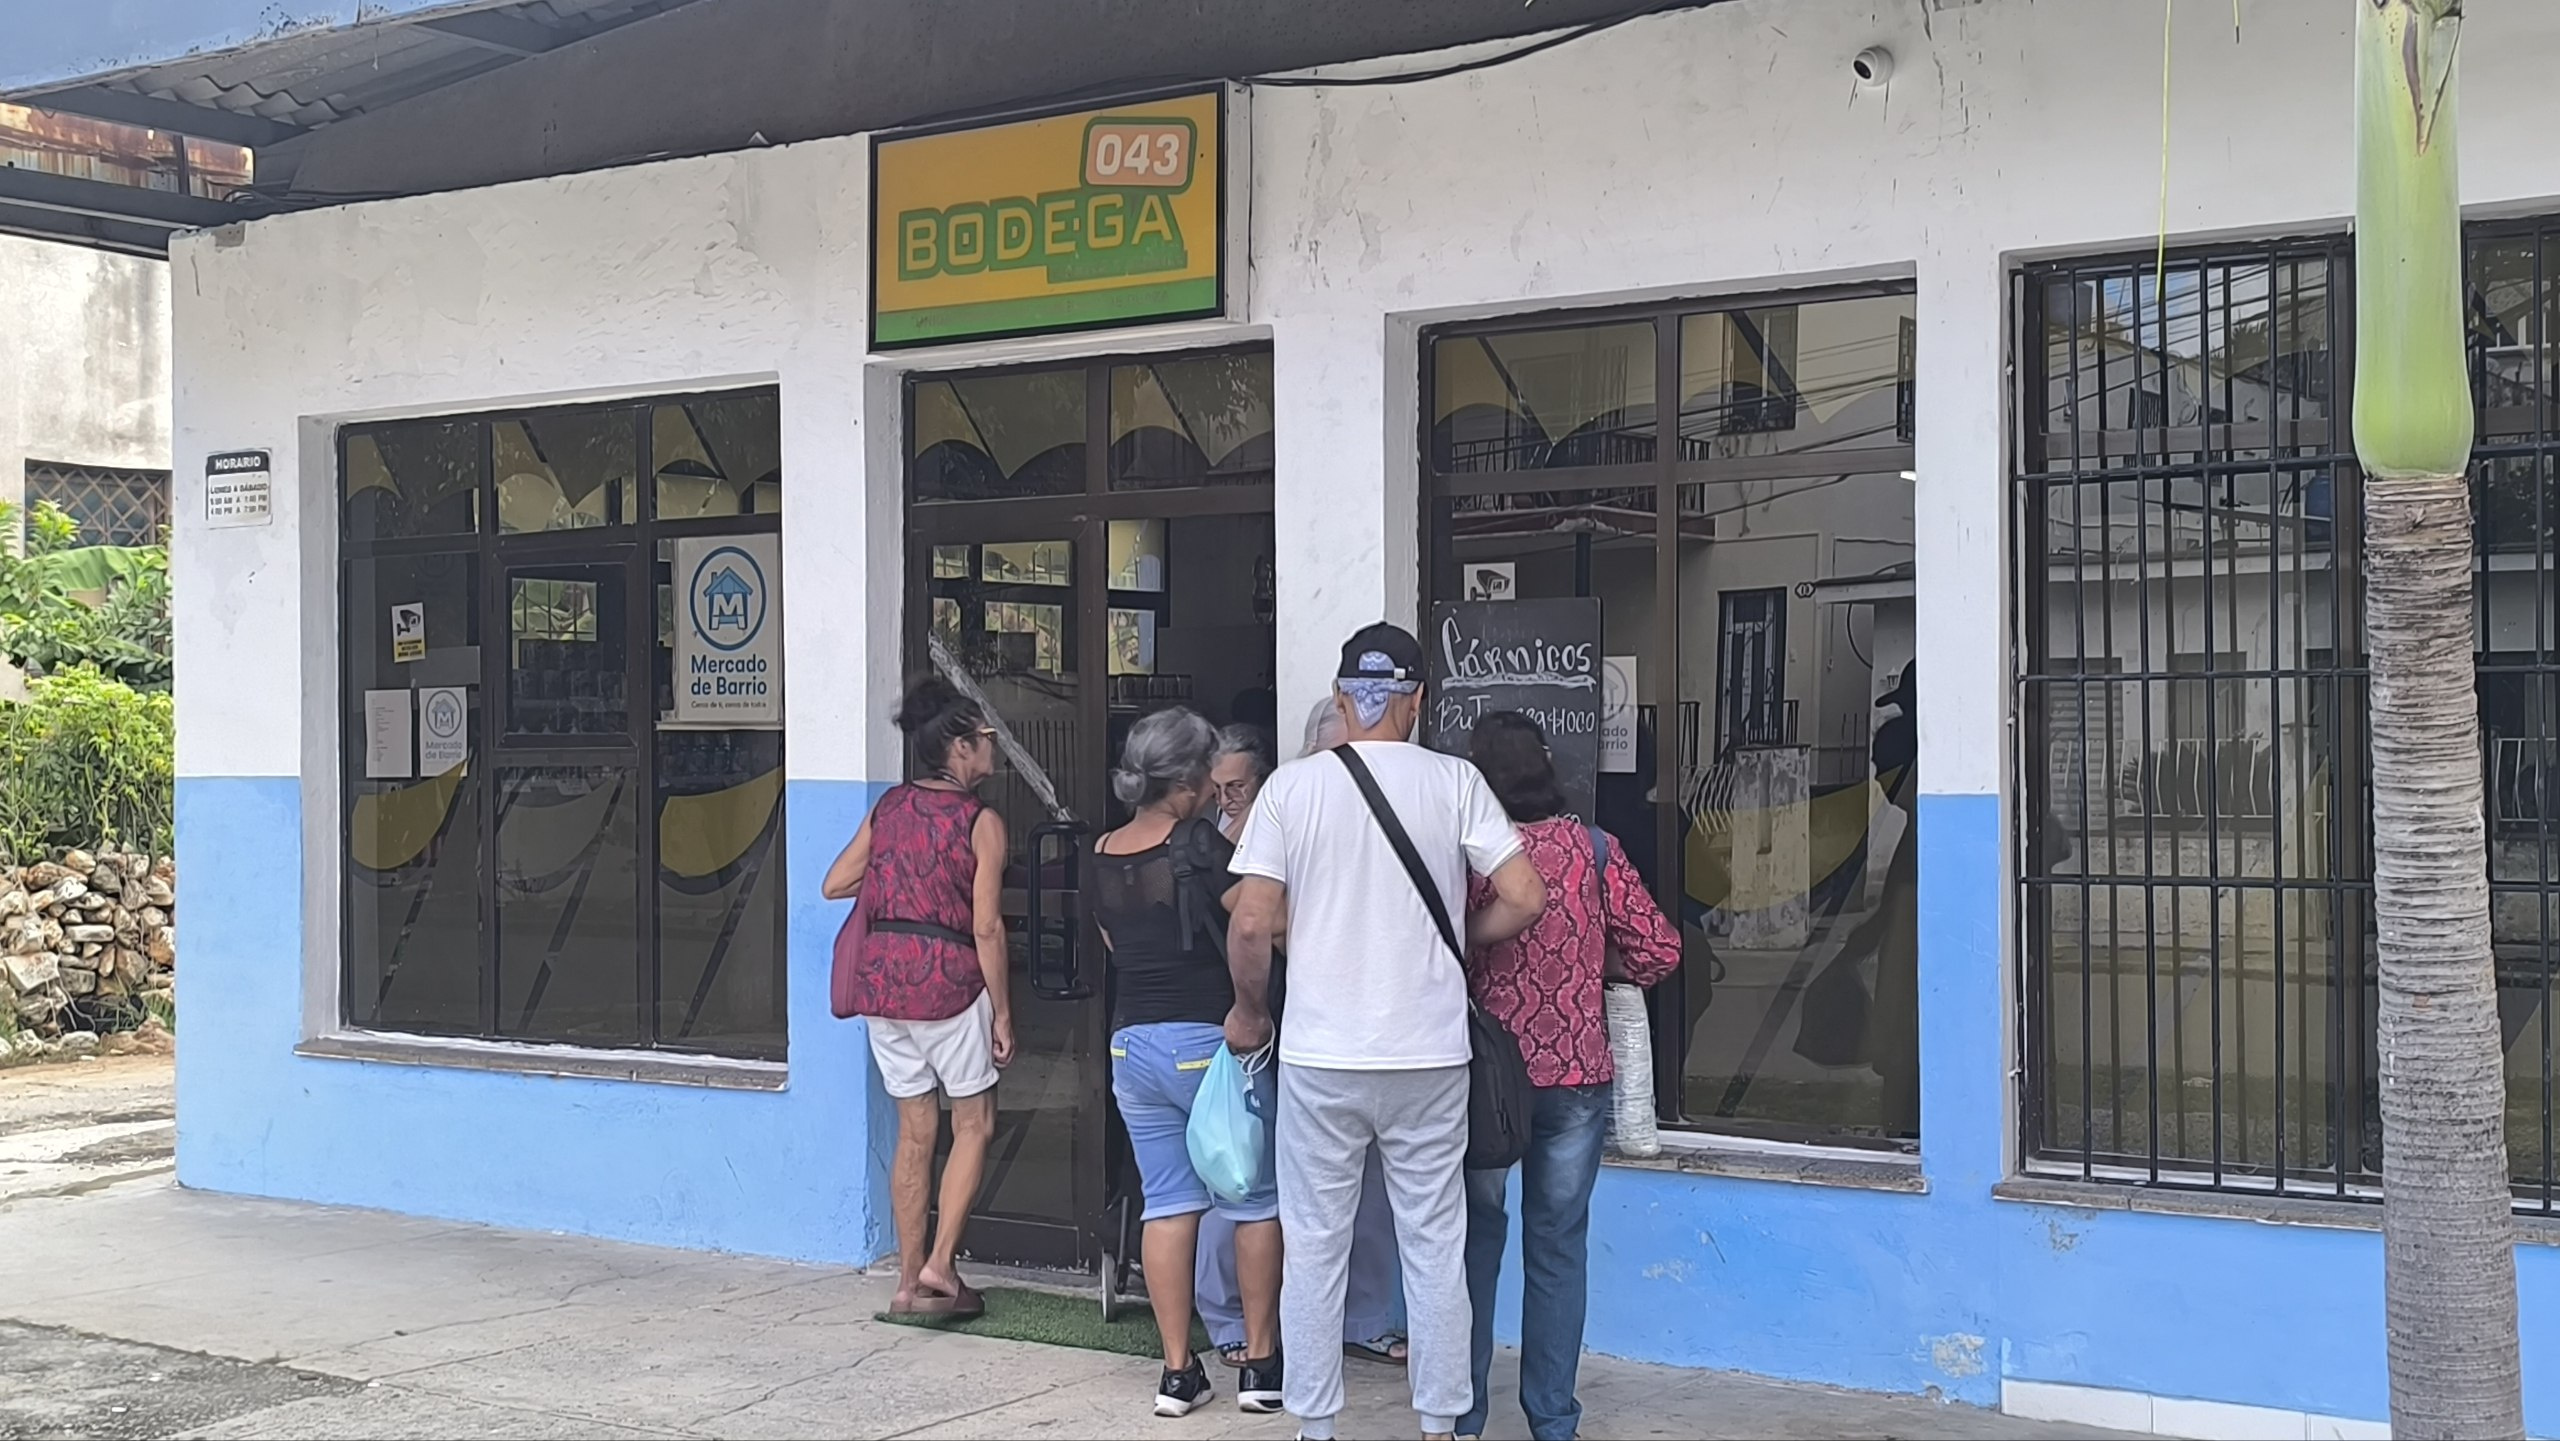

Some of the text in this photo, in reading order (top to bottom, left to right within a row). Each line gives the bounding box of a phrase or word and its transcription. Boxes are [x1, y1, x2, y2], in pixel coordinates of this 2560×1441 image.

[1095, 133, 1180, 176] 043
[905, 193, 1174, 273] BODEGA
[215, 456, 261, 470] HORARIO
[691, 653, 767, 674] Mercado
[691, 675, 767, 695] de Barrio
